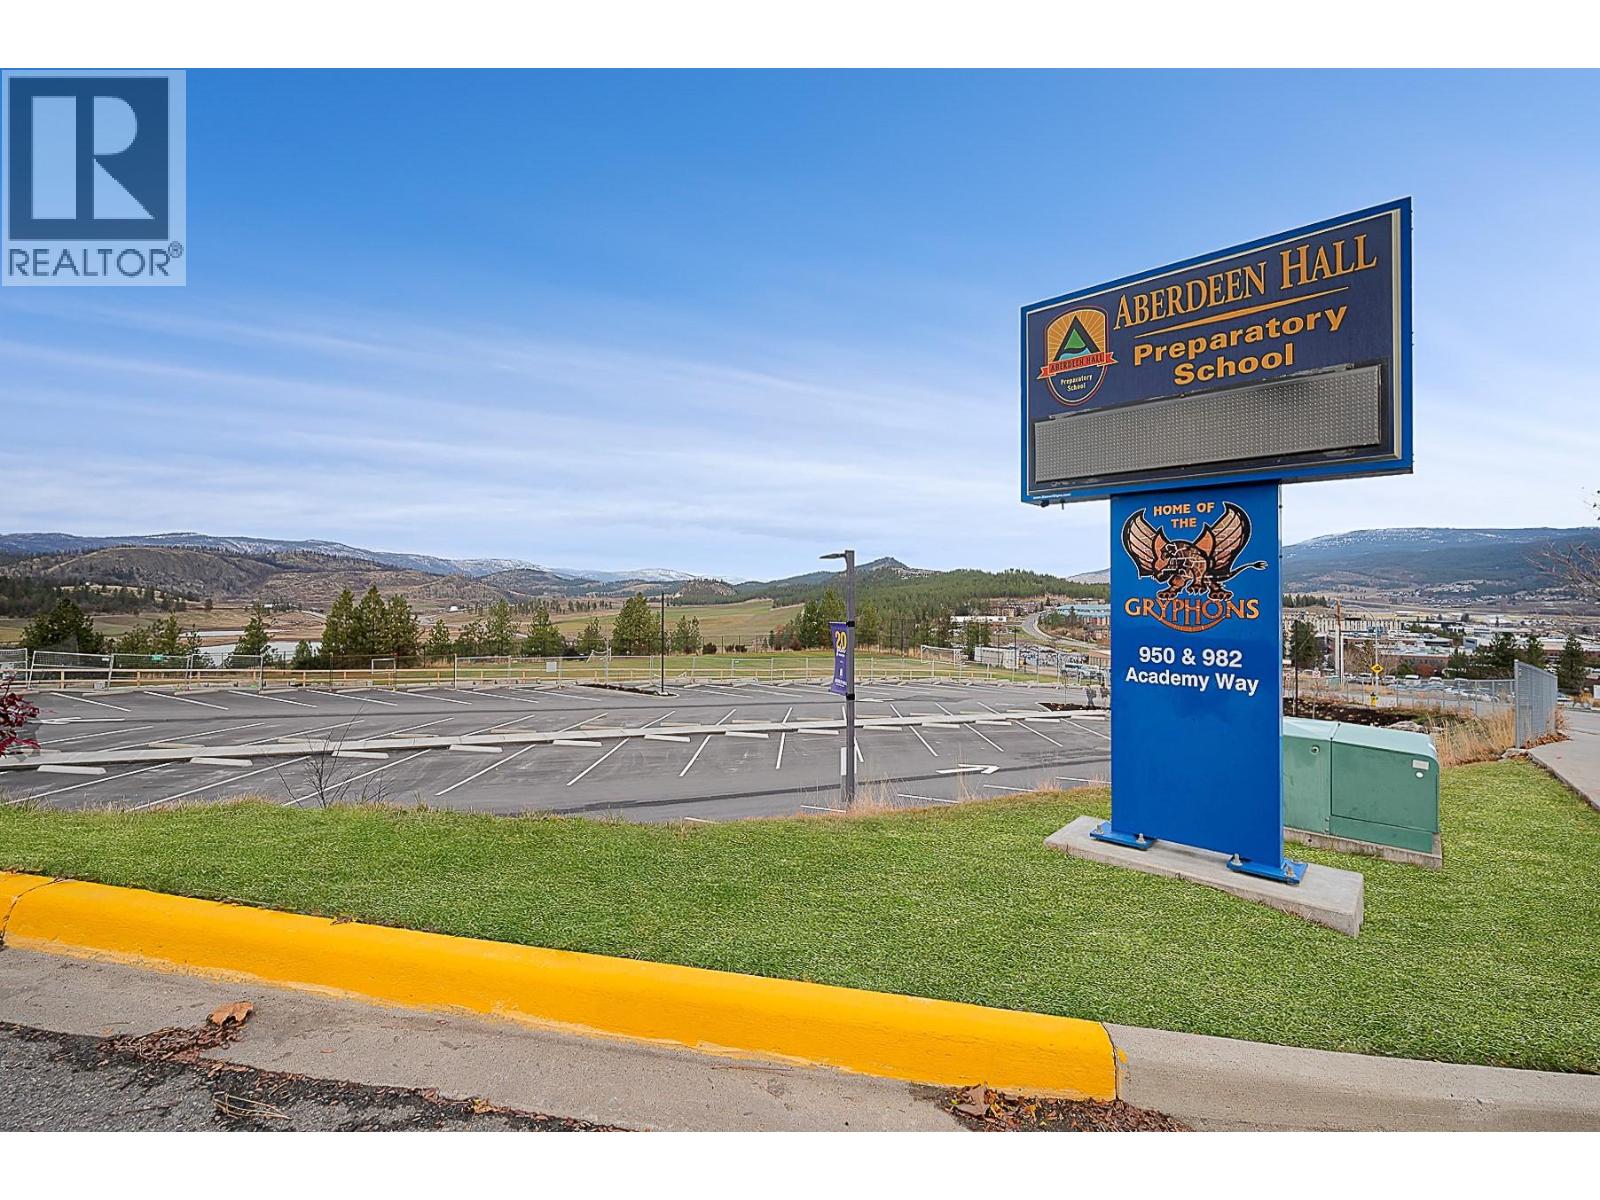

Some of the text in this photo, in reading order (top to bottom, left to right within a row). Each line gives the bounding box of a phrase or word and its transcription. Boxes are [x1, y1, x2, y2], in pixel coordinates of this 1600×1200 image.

[1113, 234, 1377, 330] ABERDEEN HALL
[1133, 306, 1348, 366] Preparatory
[1049, 358, 1084, 372] ABERDEEN
[1173, 342, 1295, 386] School
[1060, 375, 1093, 385] Preparatory
[1067, 383, 1086, 392] School
[1153, 501, 1215, 516] HOME OF
[1171, 517, 1197, 529] THE
[1124, 597, 1260, 633] GRYPHONS
[1138, 646, 1243, 668] 950 & 982
[1125, 667, 1259, 696] Academy Way
